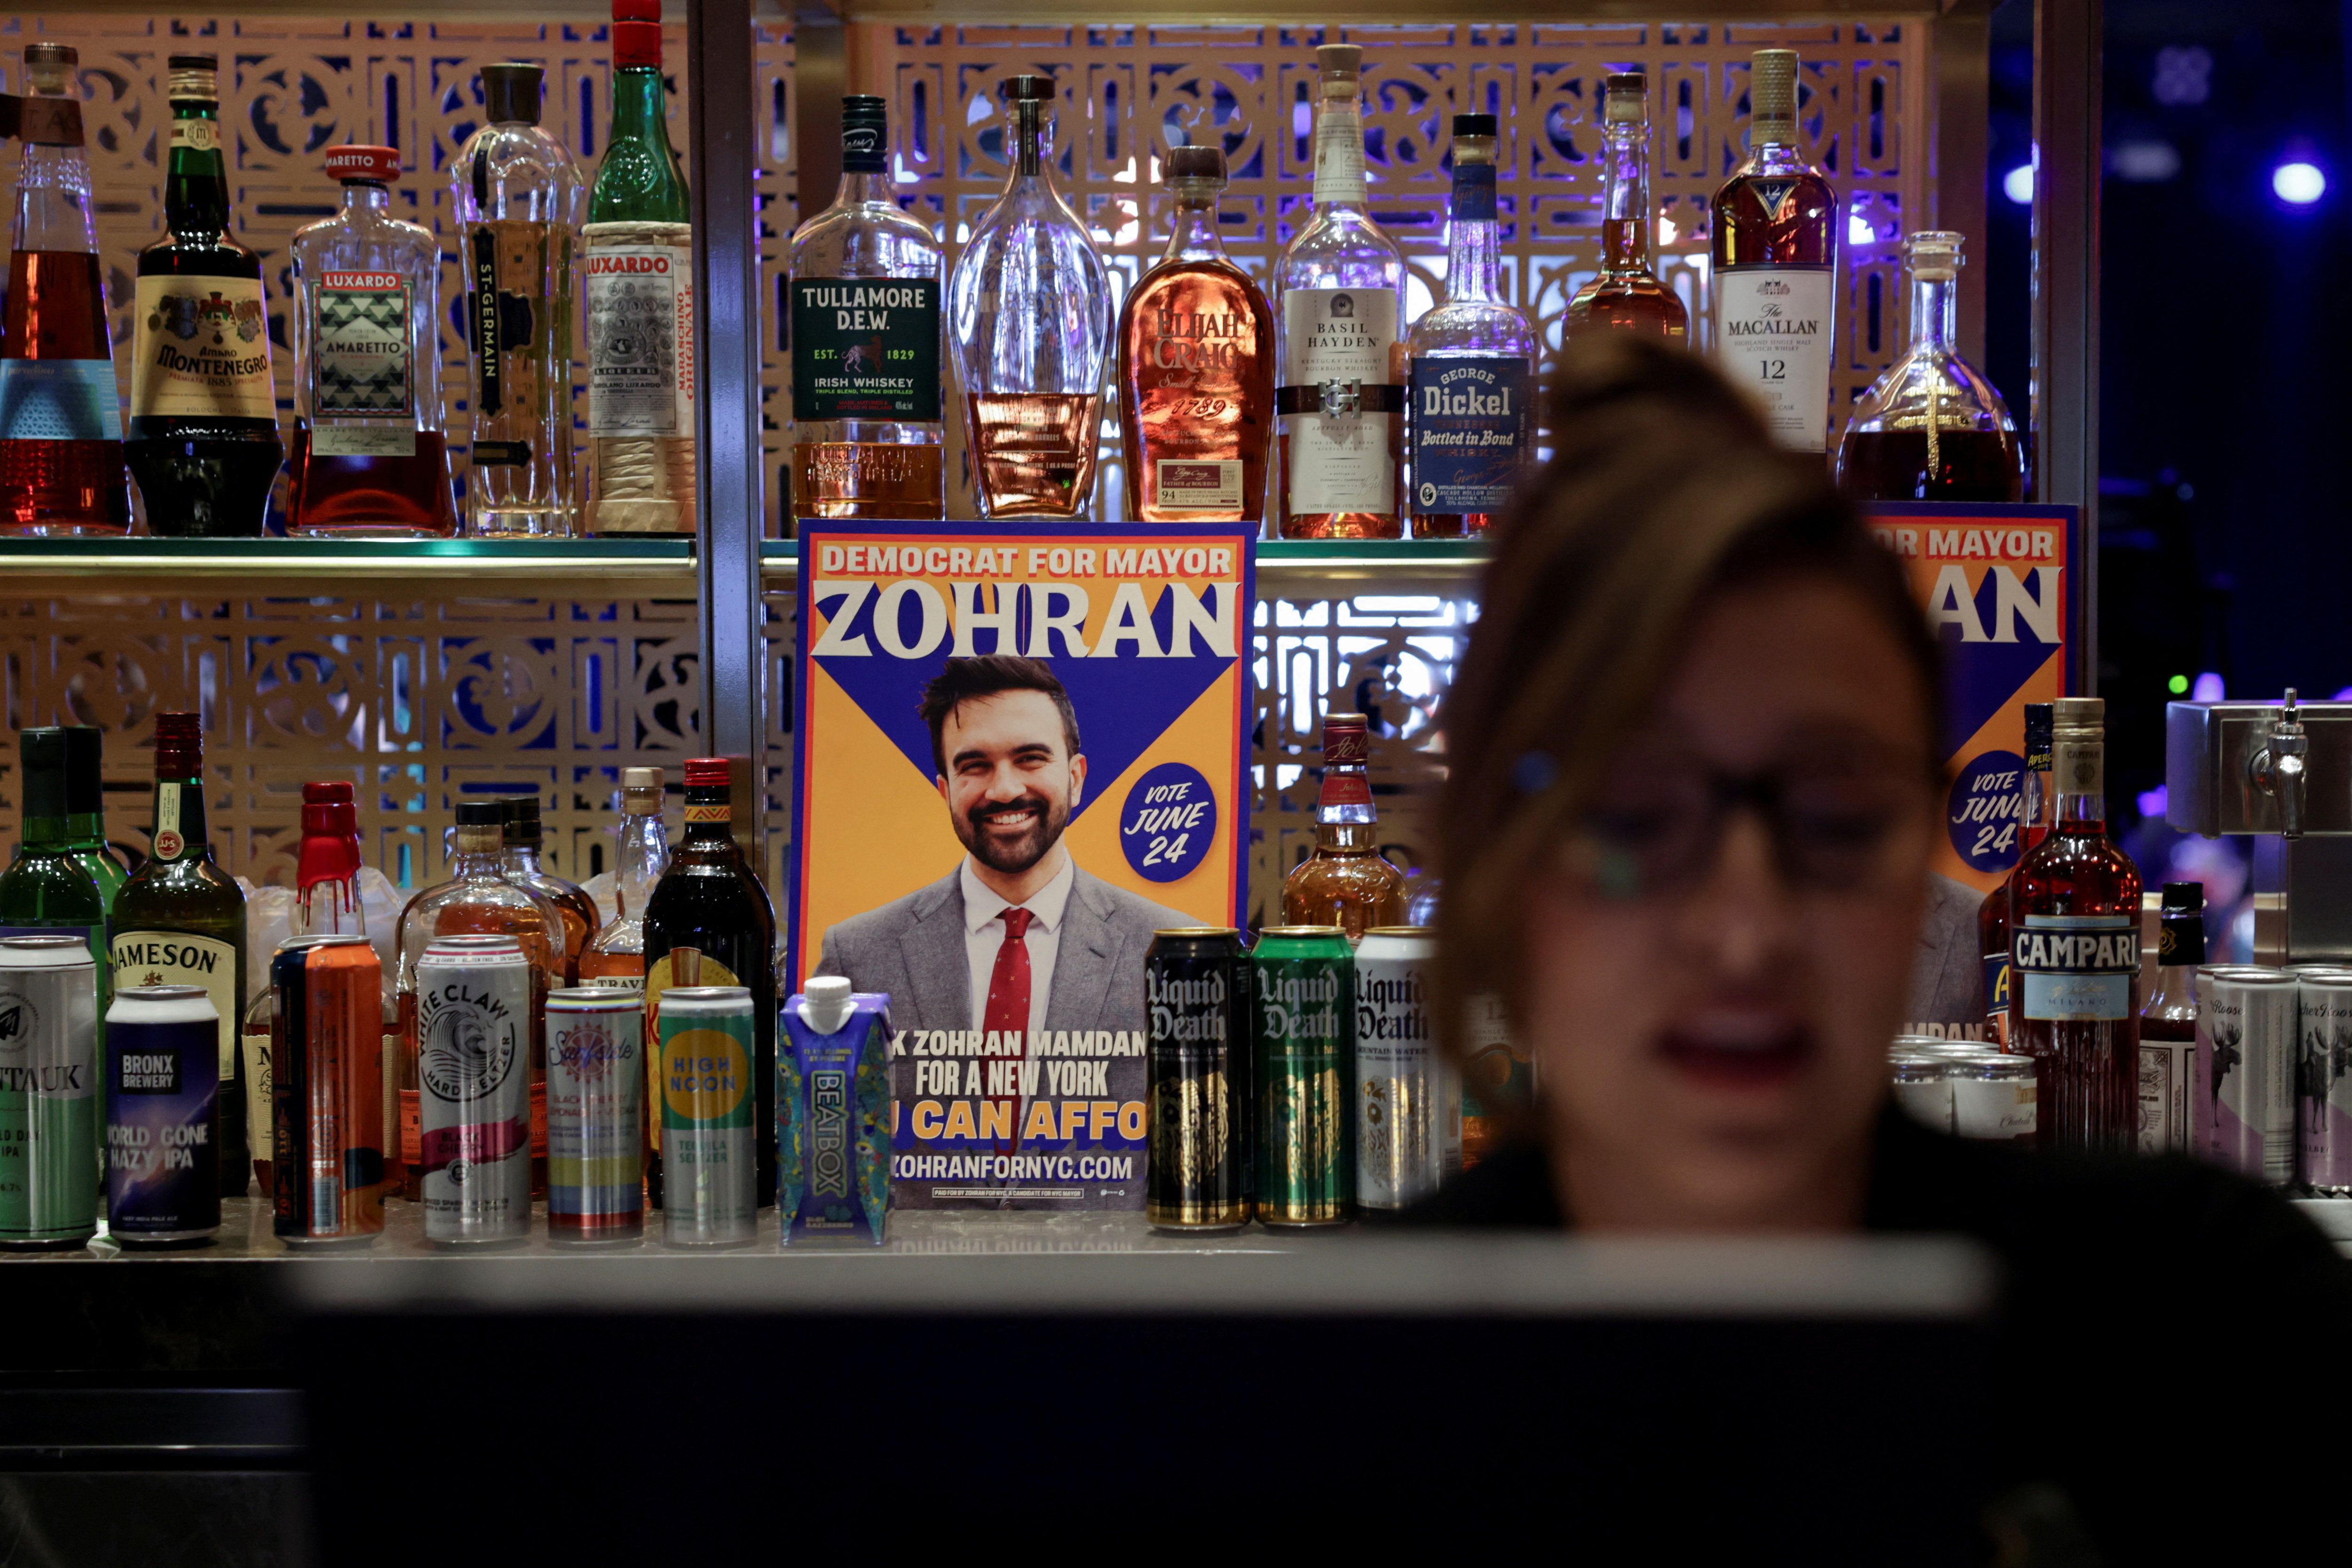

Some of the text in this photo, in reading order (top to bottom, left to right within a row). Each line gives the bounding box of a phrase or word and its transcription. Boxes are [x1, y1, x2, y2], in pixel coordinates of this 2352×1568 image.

[1764, 184, 1780, 196] 12
[326, 274, 396, 287] LUXARDO
[802, 287, 925, 308] TULLAMORE
[480, 264, 497, 377] ST-GERMAIN
[836, 310, 890, 330] D.E.W.
[1759, 303, 1783, 319] The
[1157, 309, 1240, 343] ELIJAH
[1317, 323, 1368, 333] BASIL
[1728, 320, 1818, 335] MACALLAN
[326, 342, 400, 354] AMARETTO
[685, 284, 694, 400] ORIGINALE
[1308, 337, 1376, 347] HAYDEN
[157, 344, 268, 375] MONTENEGRO
[814, 349, 915, 360] EST. 1829
[1153, 338, 1239, 374] CRAIG
[1440, 368, 1496, 384] GEORGE
[1760, 360, 1785, 379] 12
[207, 377, 232, 386] 1885
[815, 378, 914, 388] IRISH WHISKEY
[1159, 373, 1196, 389] Small
[1171, 397, 1227, 417] 1789
[1423, 386, 1510, 415] Dickel
[1421, 430, 1514, 446] Bottled in Bond
[1161, 490, 1176, 499] 94
[1927, 529, 2053, 559] MAYOR
[822, 546, 1232, 577] DEMOCRAT FOR MAYOR
[810, 579, 1242, 659] ZOHRAN
[1971, 770, 2019, 793] VOTE
[1144, 782, 1192, 804] VOTE
[1124, 801, 1209, 835] JUNE
[1143, 833, 1190, 867] 24
[1971, 823, 2017, 857] 24
[2016, 933, 2137, 967] CAMPARI
[1146, 967, 1225, 1014] Liquid
[1257, 966, 1339, 1012] Liquid
[420, 984, 509, 1057] WHITE CLAW
[1151, 1004, 1225, 1041] Death
[1263, 1004, 1339, 1040] Death
[1358, 1005, 1429, 1040] Death
[549, 1031, 634, 1069] Surfside
[913, 1030, 1022, 1056] ZOHRAN
[122, 1055, 174, 1075] BRONX
[426, 1036, 510, 1097] HARD SELTZER
[674, 1057, 731, 1073] HIGH
[122, 1075, 174, 1088] BREWERY
[670, 1075, 737, 1092] NOON
[915, 1060, 1109, 1096] FOR A NEW YORK
[911, 1099, 1012, 1140] CAN
[160, 1122, 208, 1147] GONE
[441, 1132, 480, 1143] BLACK
[816, 1075, 842, 1192] BEATBOX
[2, 1146, 20, 1158] IPA
[111, 1148, 194, 1170] HAZY IPA
[437, 1143, 485, 1154] CHERRY
